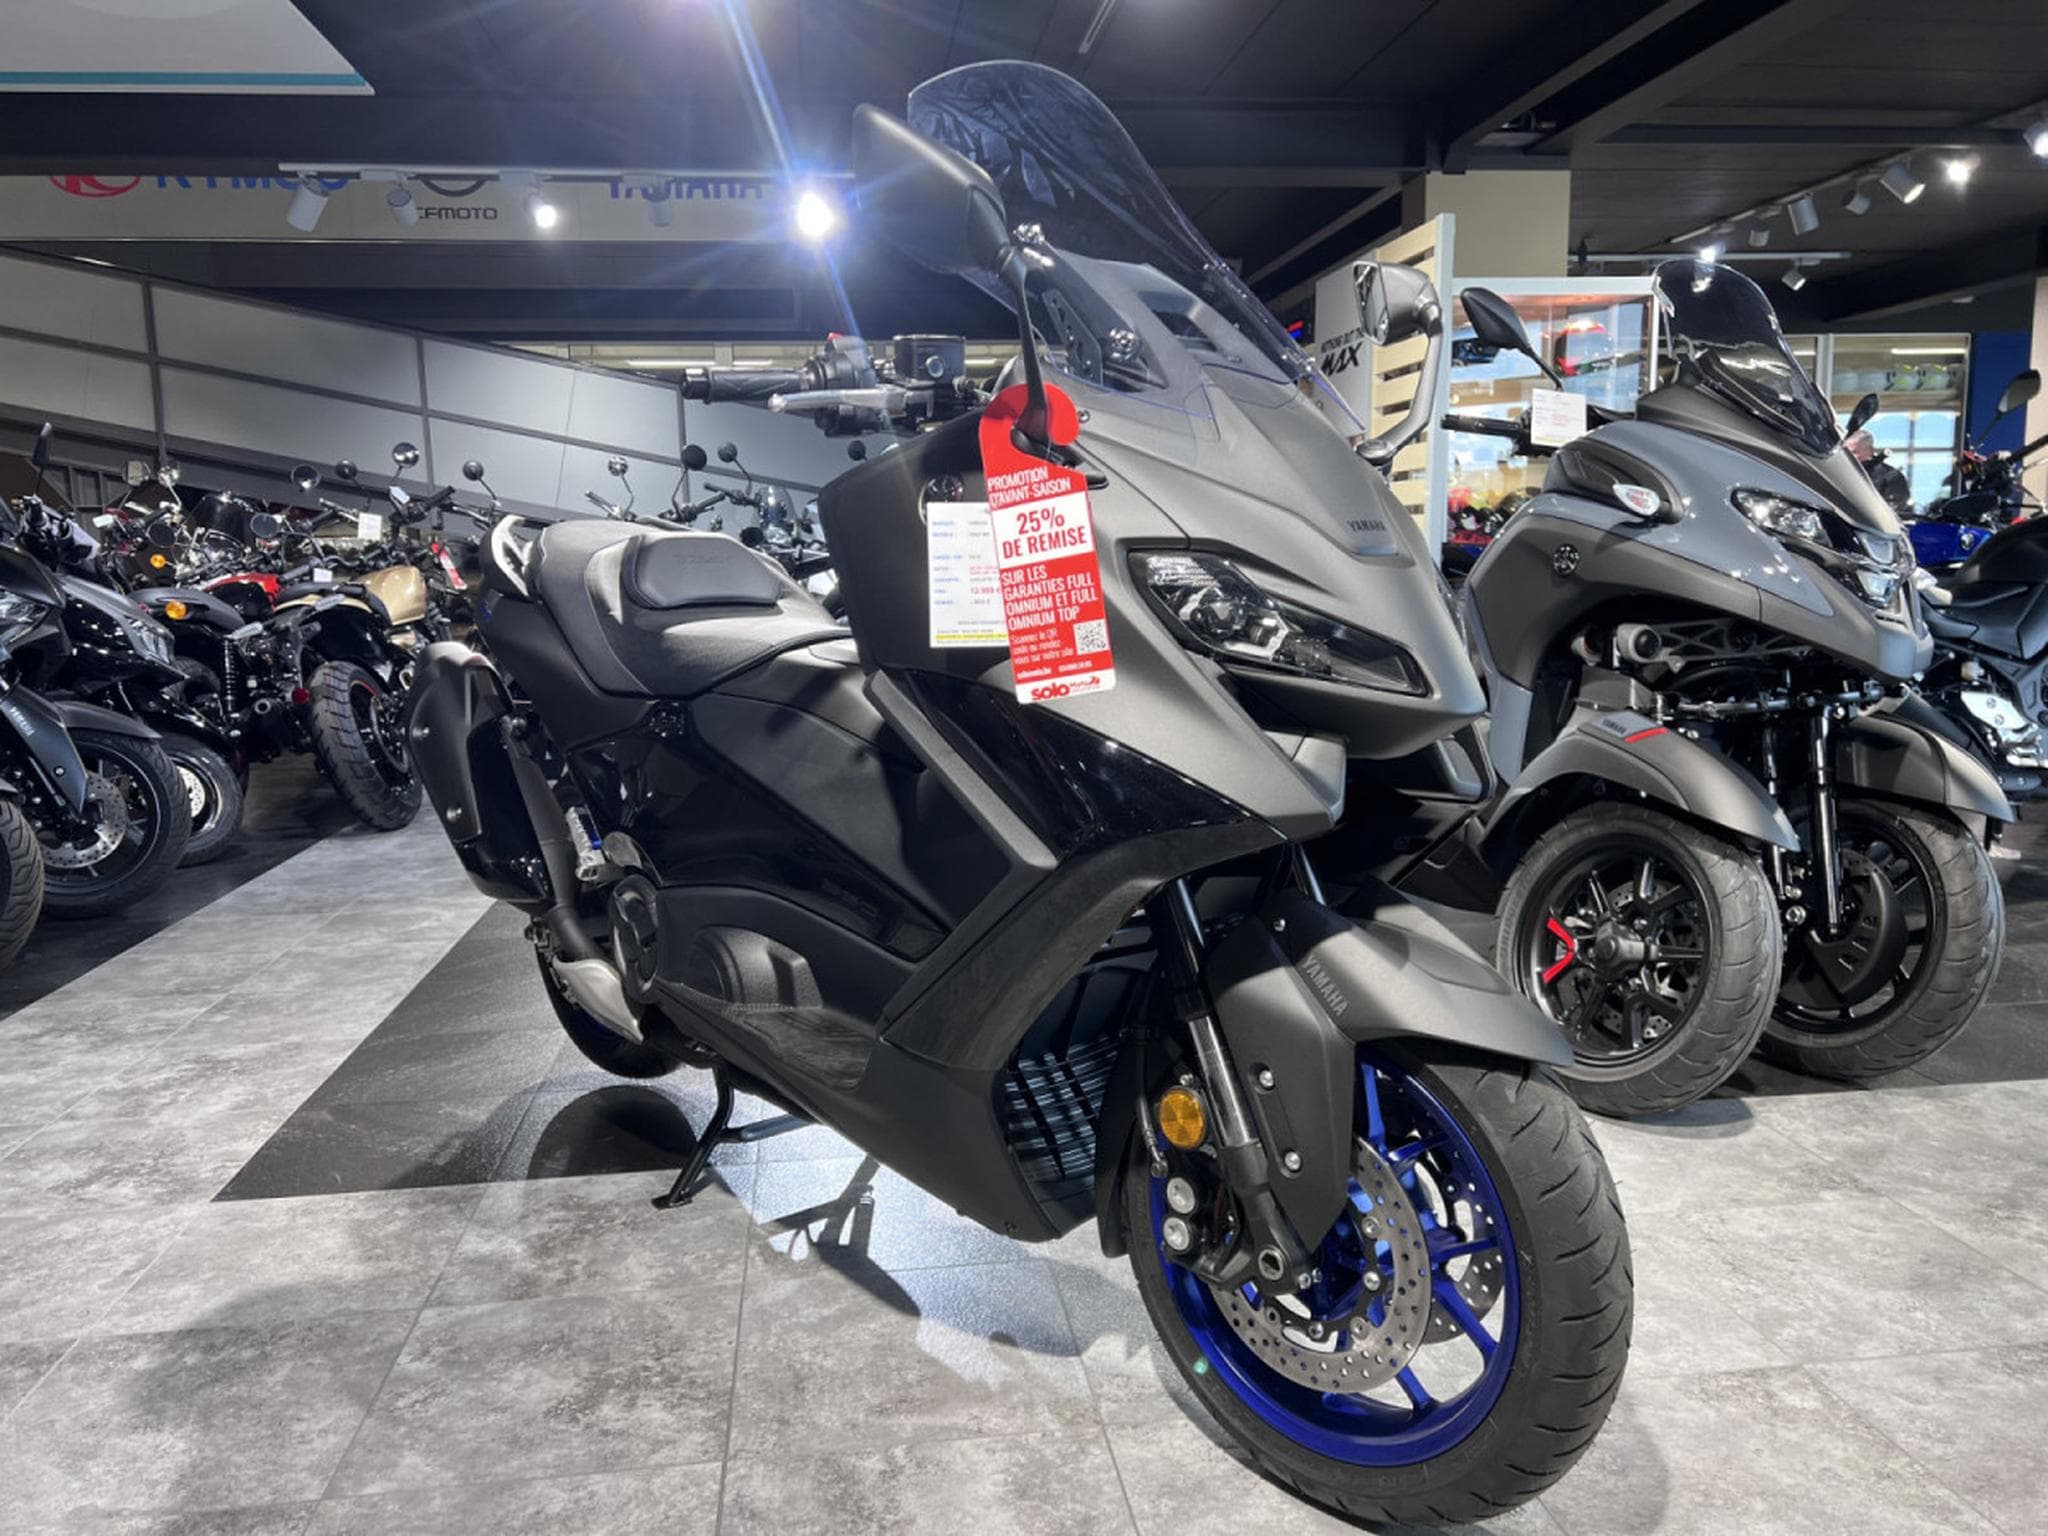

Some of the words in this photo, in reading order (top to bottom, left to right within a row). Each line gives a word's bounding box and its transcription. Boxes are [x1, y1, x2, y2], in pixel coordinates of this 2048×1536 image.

[987, 466, 1048, 491] PROMOTION
[1016, 506, 1065, 535] 25%
[1346, 519, 1386, 533] YAMAHA
[1002, 538, 1023, 559] DE
[1027, 525, 1087, 554] REMISE
[1001, 569, 1025, 586] SUR
[1027, 565, 1047, 582] LES
[1004, 578, 1065, 601] GARANTIES
[1067, 572, 1095, 590] FULL
[1006, 595, 1054, 616] OMNIUM
[1055, 592, 1069, 607] ET
[1071, 587, 1098, 605] FULL
[1008, 611, 1056, 631] OMNIUM
[1057, 606, 1080, 623] TOP
[1031, 683, 1070, 701] solo
[1302, 954, 1350, 1016] YAMAHA
